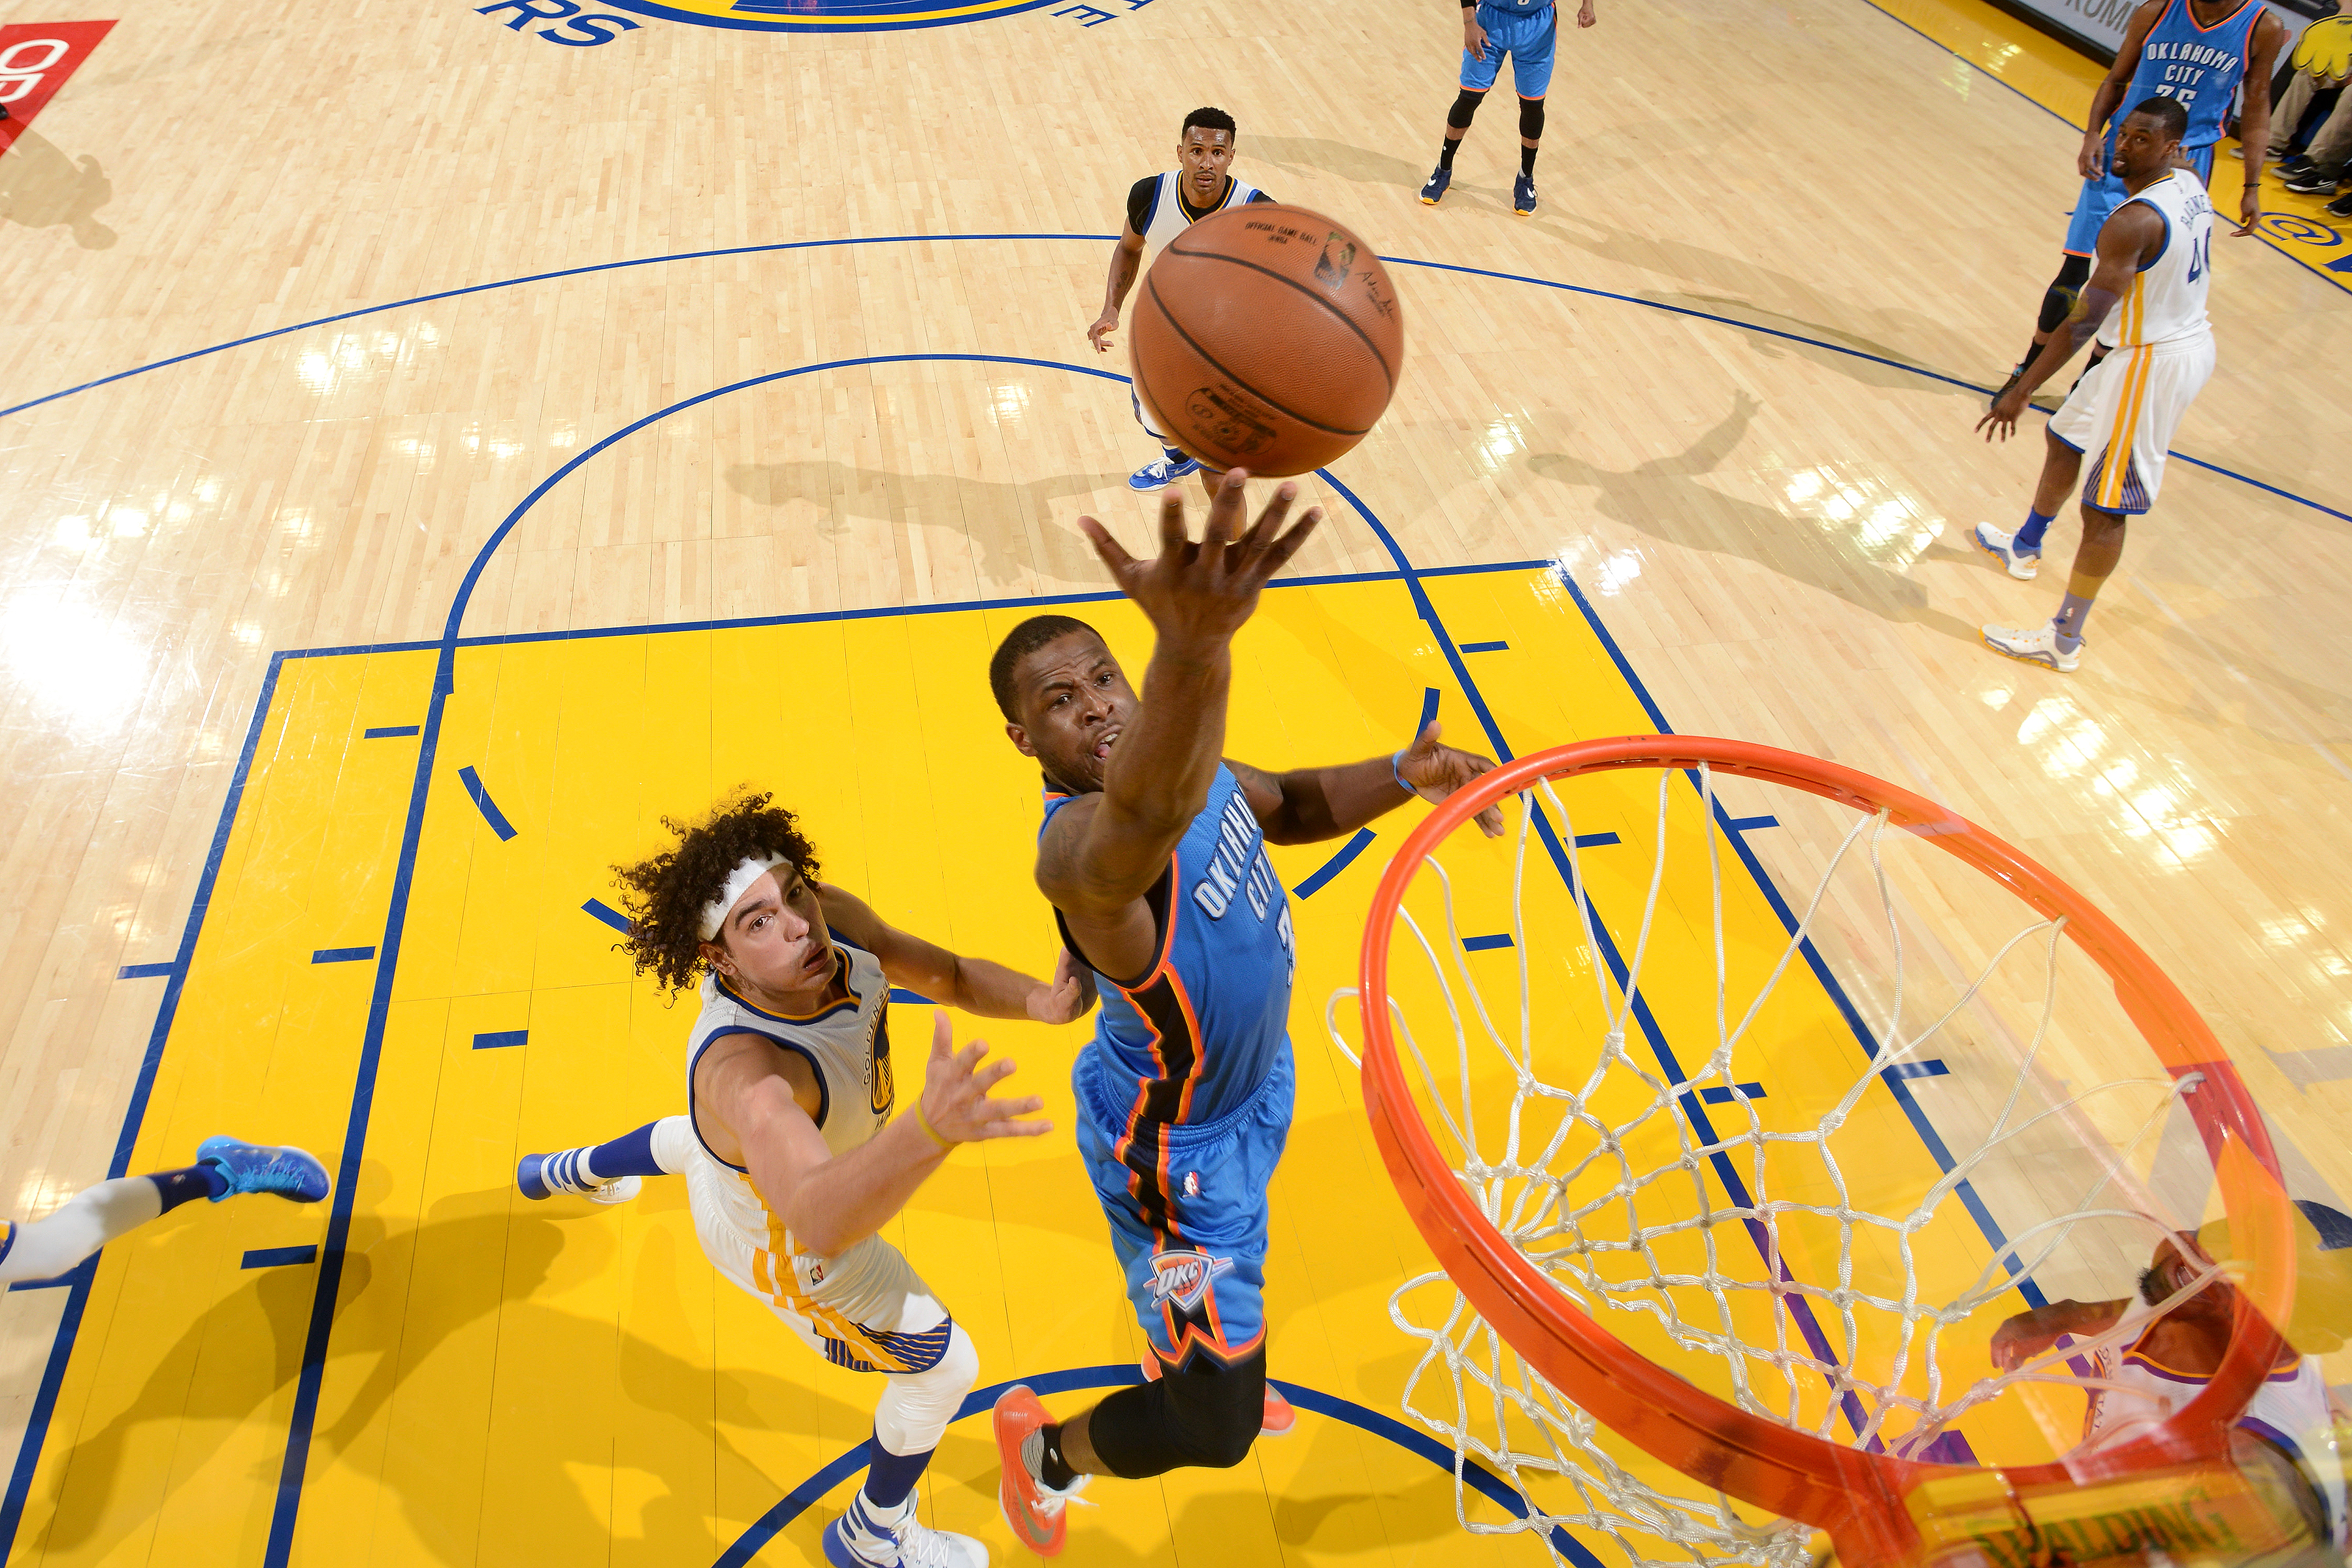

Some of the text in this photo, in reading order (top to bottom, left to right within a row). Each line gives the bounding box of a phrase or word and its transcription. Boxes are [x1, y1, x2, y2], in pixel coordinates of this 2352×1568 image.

[2147, 42, 2239, 73] OKLAHOMA
[2164, 64, 2205, 86] CITY
[1192, 781, 1258, 921] OKLAHO
[863, 1004, 880, 1086] GOLDEN
[1156, 1261, 1199, 1297] OKC
